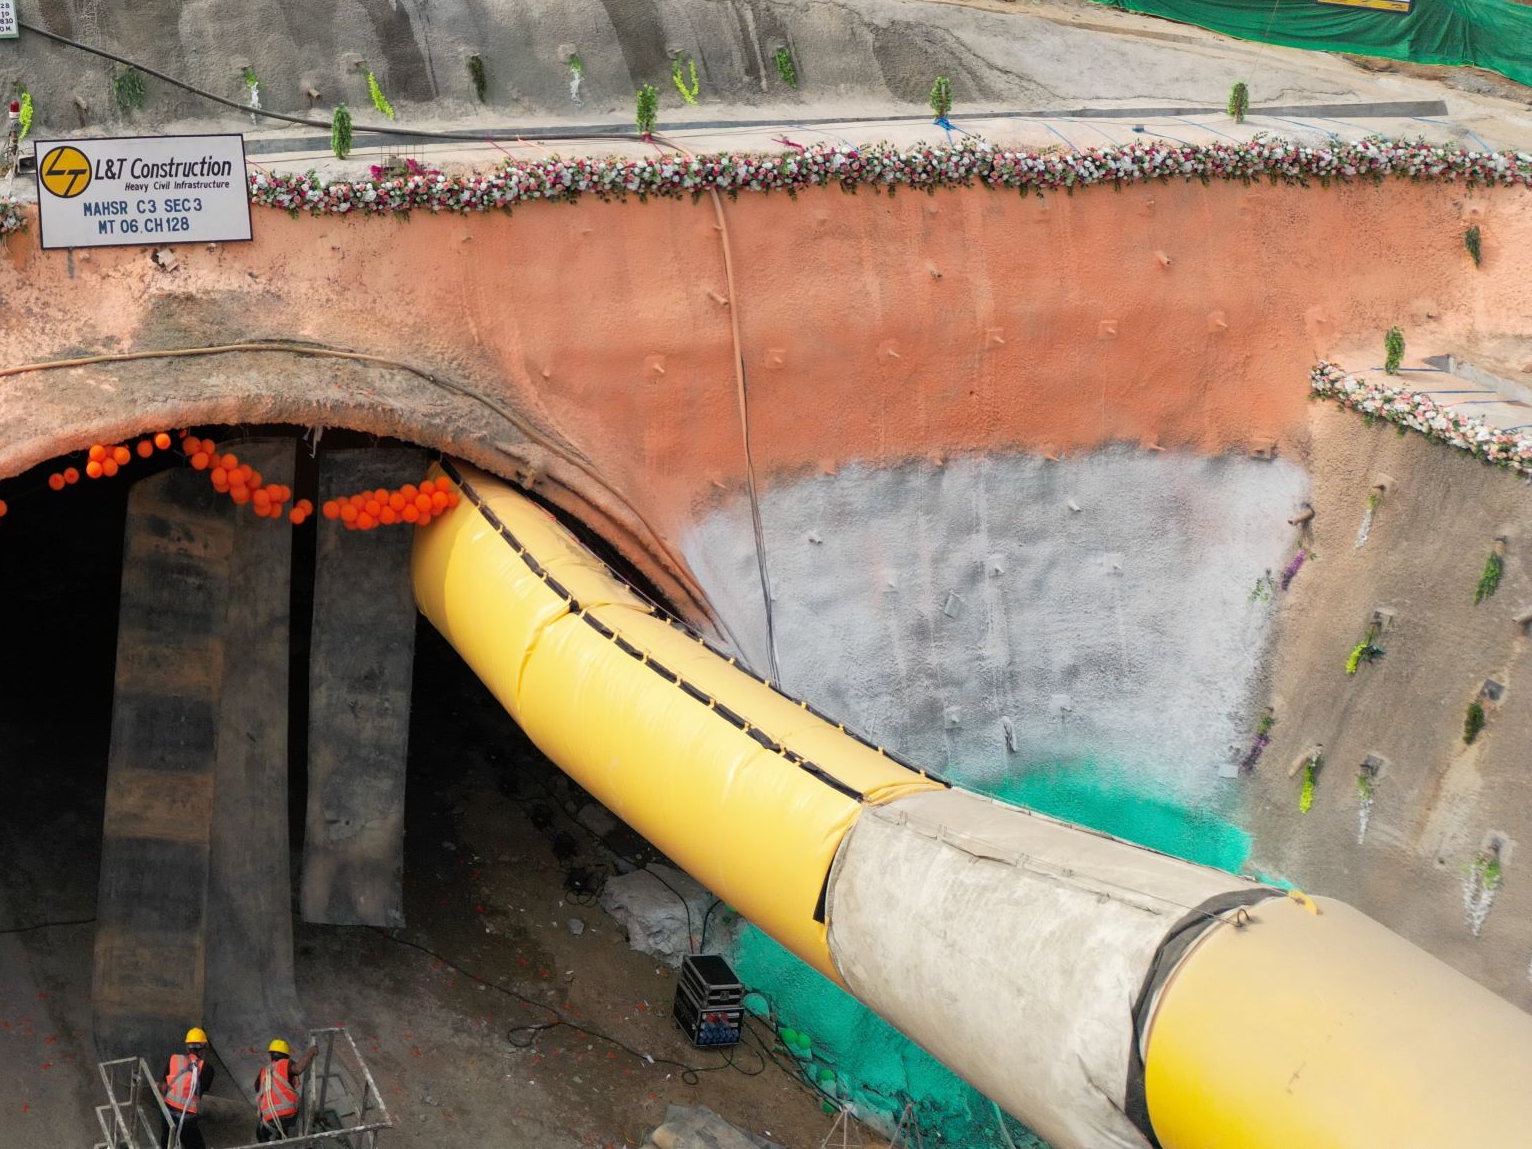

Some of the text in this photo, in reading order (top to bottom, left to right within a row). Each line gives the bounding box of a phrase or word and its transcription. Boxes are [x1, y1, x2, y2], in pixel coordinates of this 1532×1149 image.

[94, 155, 232, 180] L&T Construction
[125, 180, 230, 193] Heavy Civil Infrastructure
[83, 200, 128, 217] MAHSR
[137, 199, 157, 214] C3
[98, 219, 115, 234] MT
